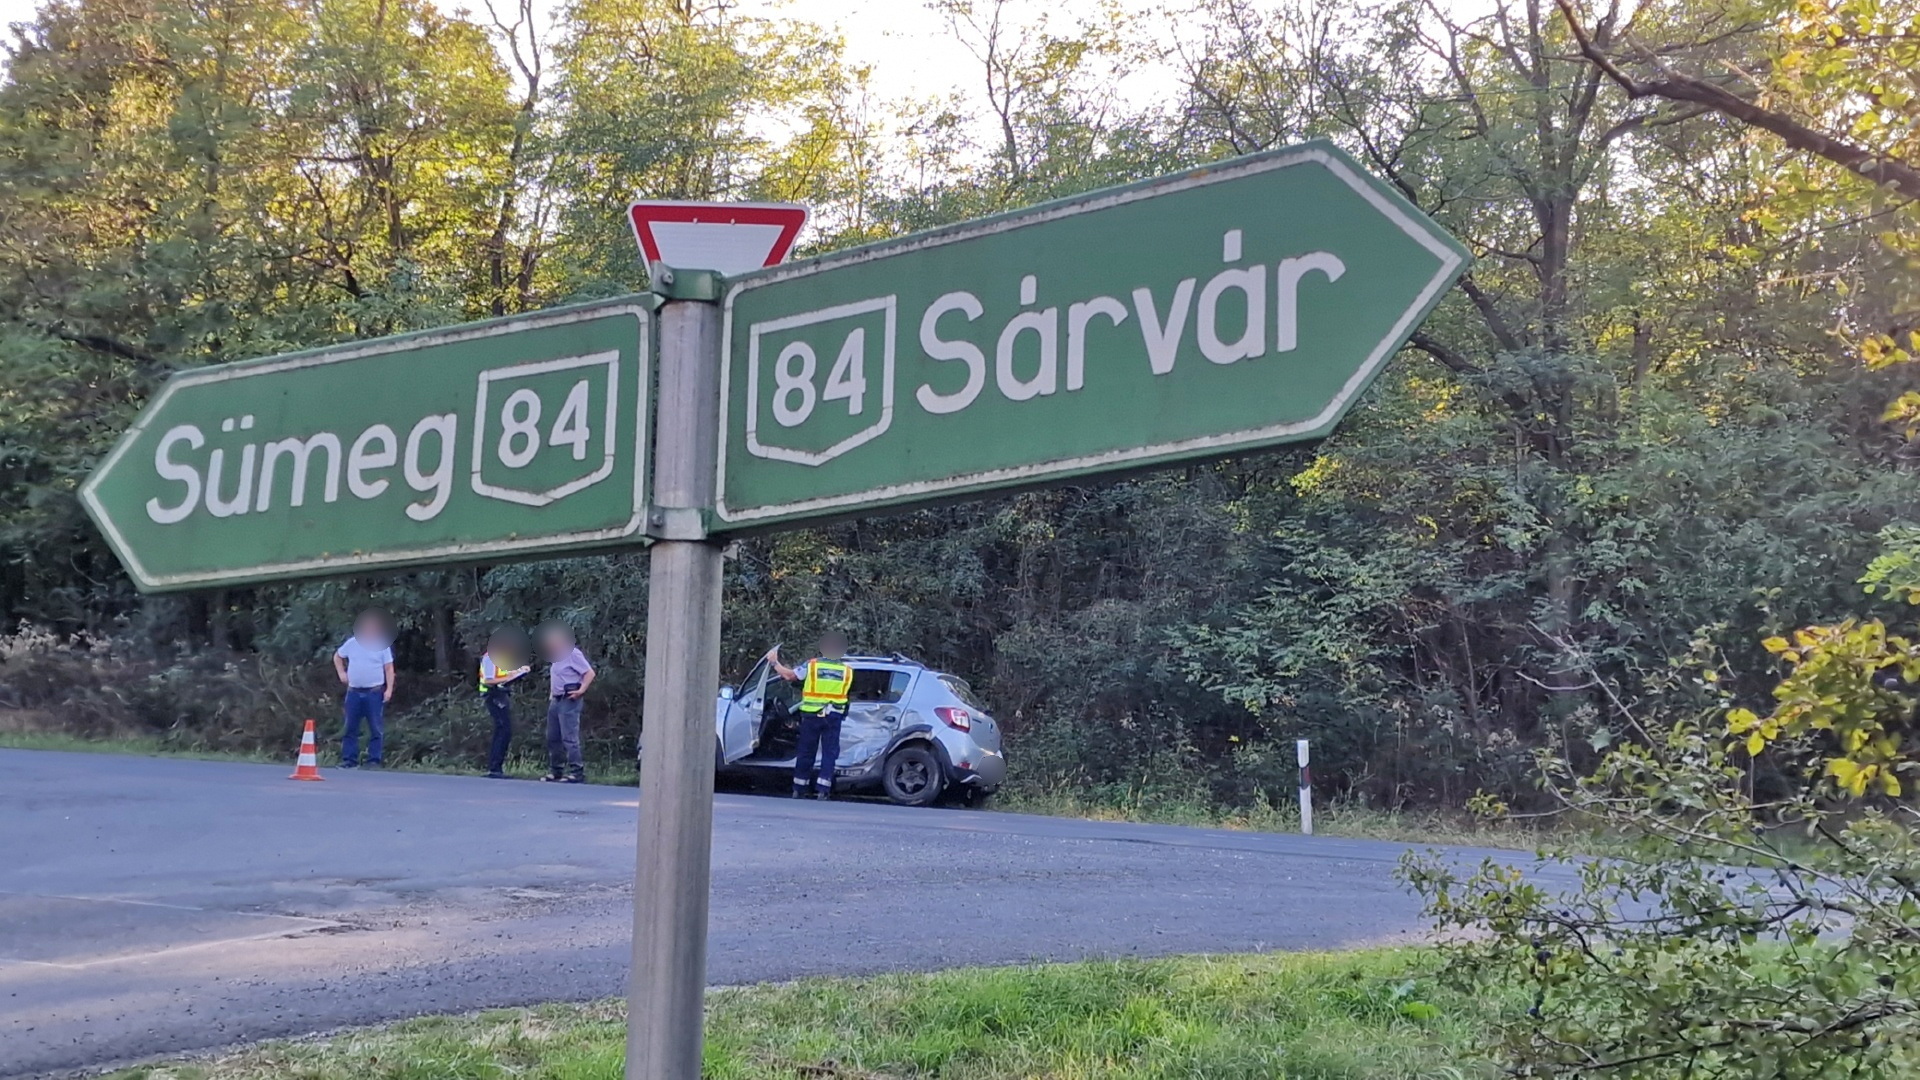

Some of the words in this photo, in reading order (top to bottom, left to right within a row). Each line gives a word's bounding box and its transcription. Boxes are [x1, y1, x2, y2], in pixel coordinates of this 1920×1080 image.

[771, 327, 867, 427] 84
[916, 229, 1346, 414] Sárvár
[146, 413, 458, 523] Sümeg
[498, 379, 590, 468] 84
